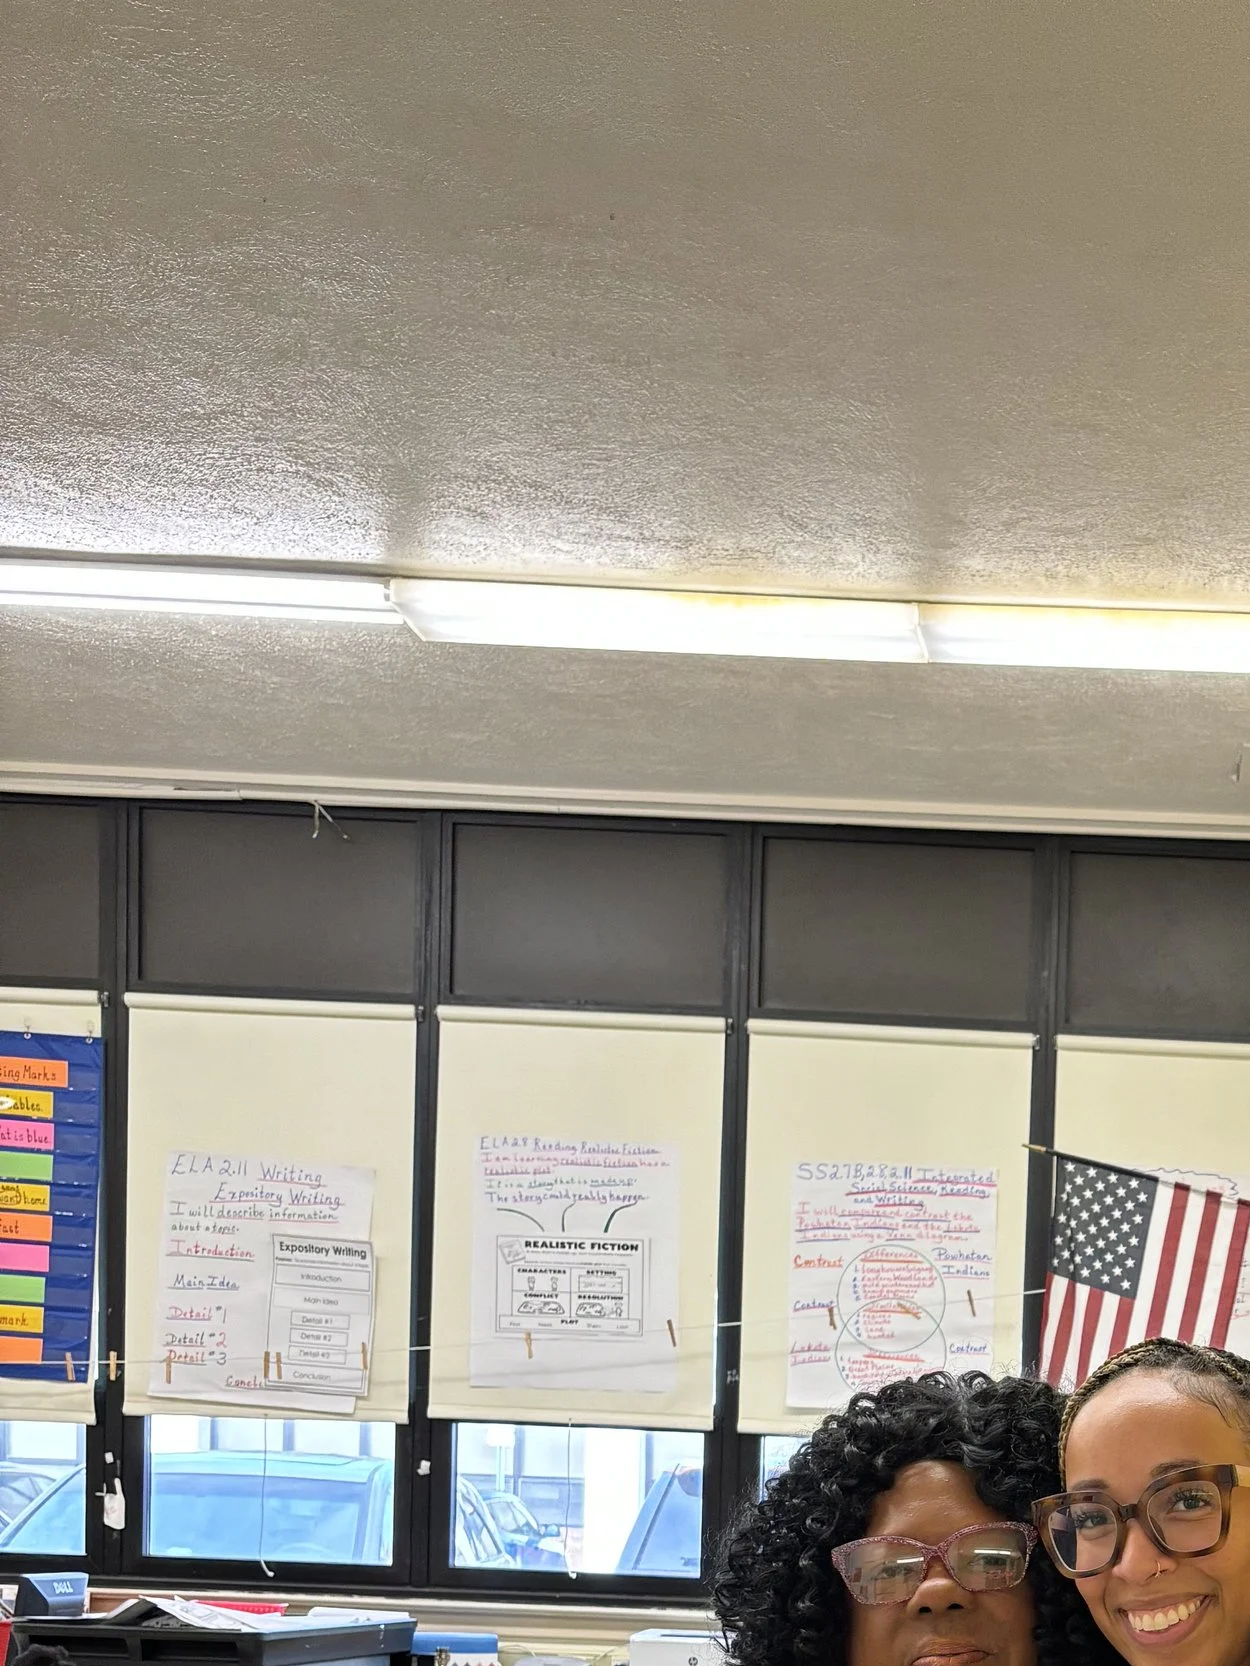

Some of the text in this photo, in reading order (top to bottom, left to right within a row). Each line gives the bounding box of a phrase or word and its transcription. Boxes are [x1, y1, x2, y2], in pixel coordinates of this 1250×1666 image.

[171, 1154, 213, 1175] ELA
[259, 1162, 323, 1189] Writing
[213, 1182, 341, 1211] Expository Writing
[875, 1194, 924, 1210] Writing
[189, 1207, 214, 1217] will
[216, 1206, 264, 1219] describe
[172, 1223, 201, 1232] about
[279, 1242, 367, 1259] Expository Writing
[525, 1240, 639, 1251] REALISTIC FICTION
[932, 1247, 992, 1261] Powhatan
[942, 1265, 990, 1276] Indians
[174, 1274, 240, 1289] Main Idea
[169, 1306, 212, 1319] Detail
[302, 1316, 323, 1324] Detail
[165, 1332, 205, 1346] Detail
[300, 1332, 321, 1341] Detail
[950, 1343, 986, 1352] Contrast
[167, 1350, 206, 1363] Detail
[53, 1581, 73, 1594] DELL
